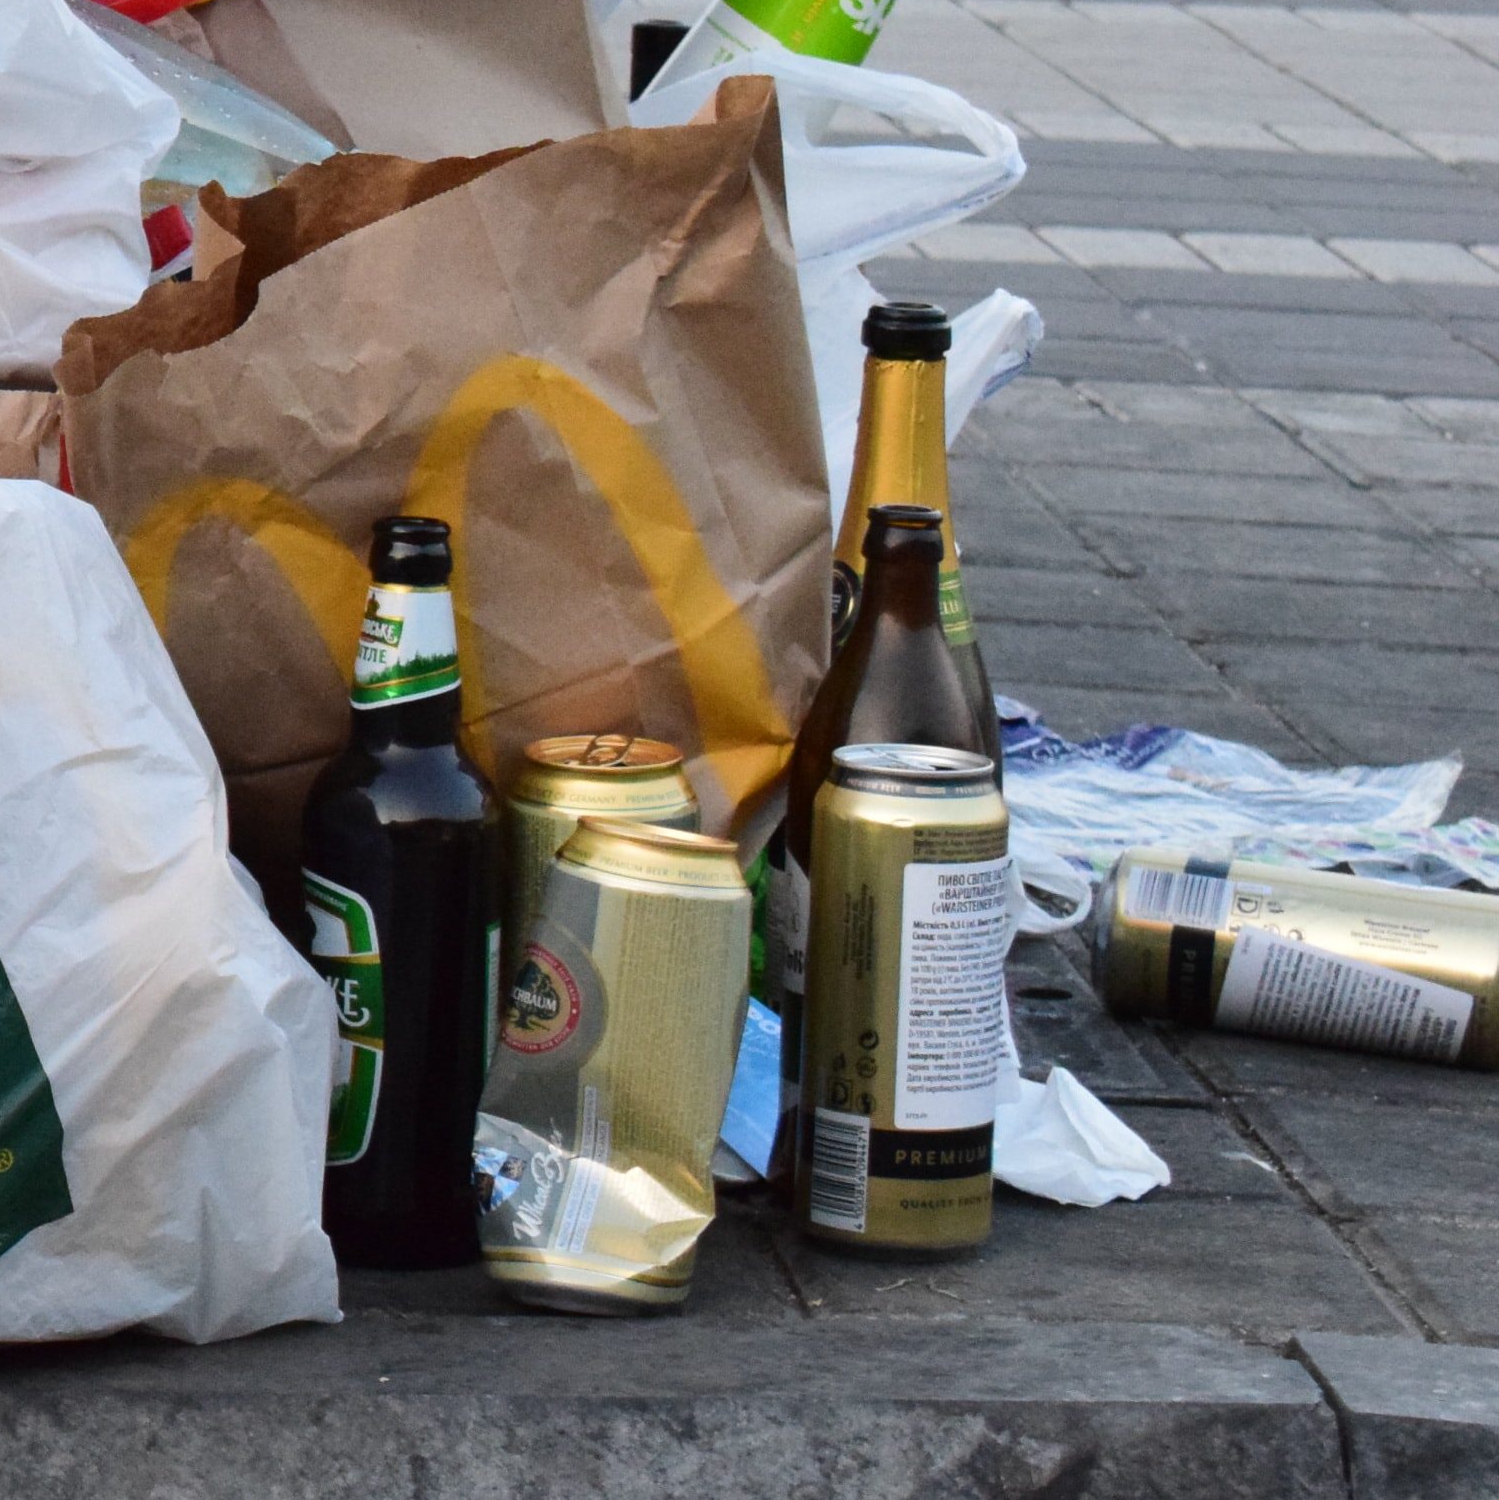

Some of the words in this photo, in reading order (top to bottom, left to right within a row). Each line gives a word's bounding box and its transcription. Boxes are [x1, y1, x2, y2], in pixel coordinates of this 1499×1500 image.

[569, 792, 616, 805] GERMANY
[938, 874, 965, 887] ПИВО
[894, 1145, 987, 1166] PREMIUM
